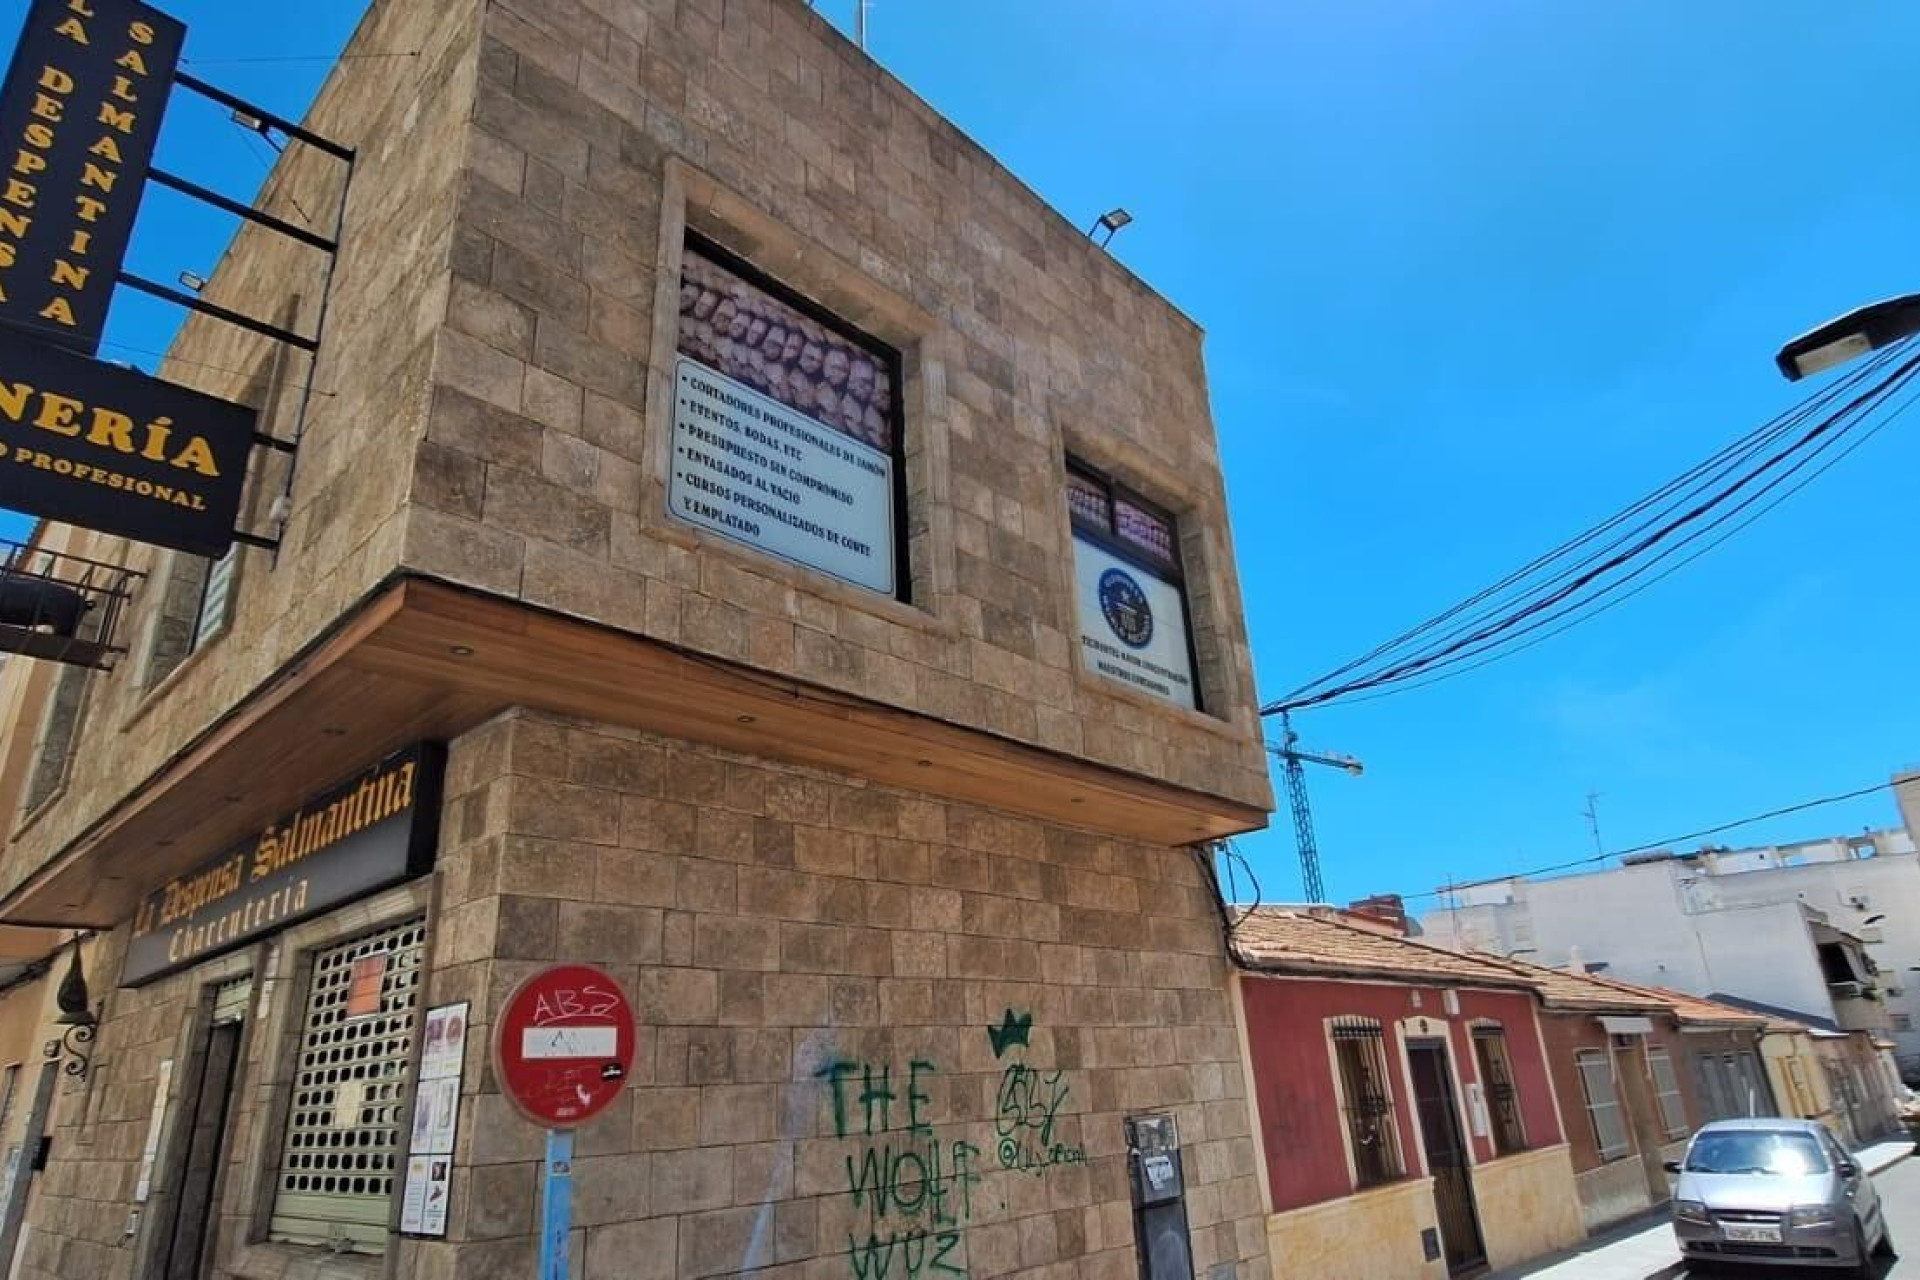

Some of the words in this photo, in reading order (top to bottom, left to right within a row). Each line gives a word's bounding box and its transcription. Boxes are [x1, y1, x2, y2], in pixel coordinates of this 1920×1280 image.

[0, 65, 74, 301] DESPENS
[39, 21, 155, 326] SALMANTINA
[690, 377, 761, 420] CORTADORES
[763, 411, 841, 458] PROFESIONALES
[784, 444, 802, 462] ETC
[15, 447, 207, 511] PROFESIONAL
[687, 447, 753, 487] ENVASADOS
[755, 476, 769, 493] AL
[688, 423, 768, 469] PRESUPUESTO
[770, 459, 787, 477] SIN
[789, 468, 854, 506] COMPROMISO
[685, 471, 731, 502] CURSOS
[733, 491, 826, 540] PERSONALIZADOS
[827, 529, 840, 545] DE
[693, 500, 760, 537] EMPLATADO
[250, 761, 417, 884] Salmantina
[814, 1059, 935, 1139] THE
[846, 1139, 982, 1225] WOLF
